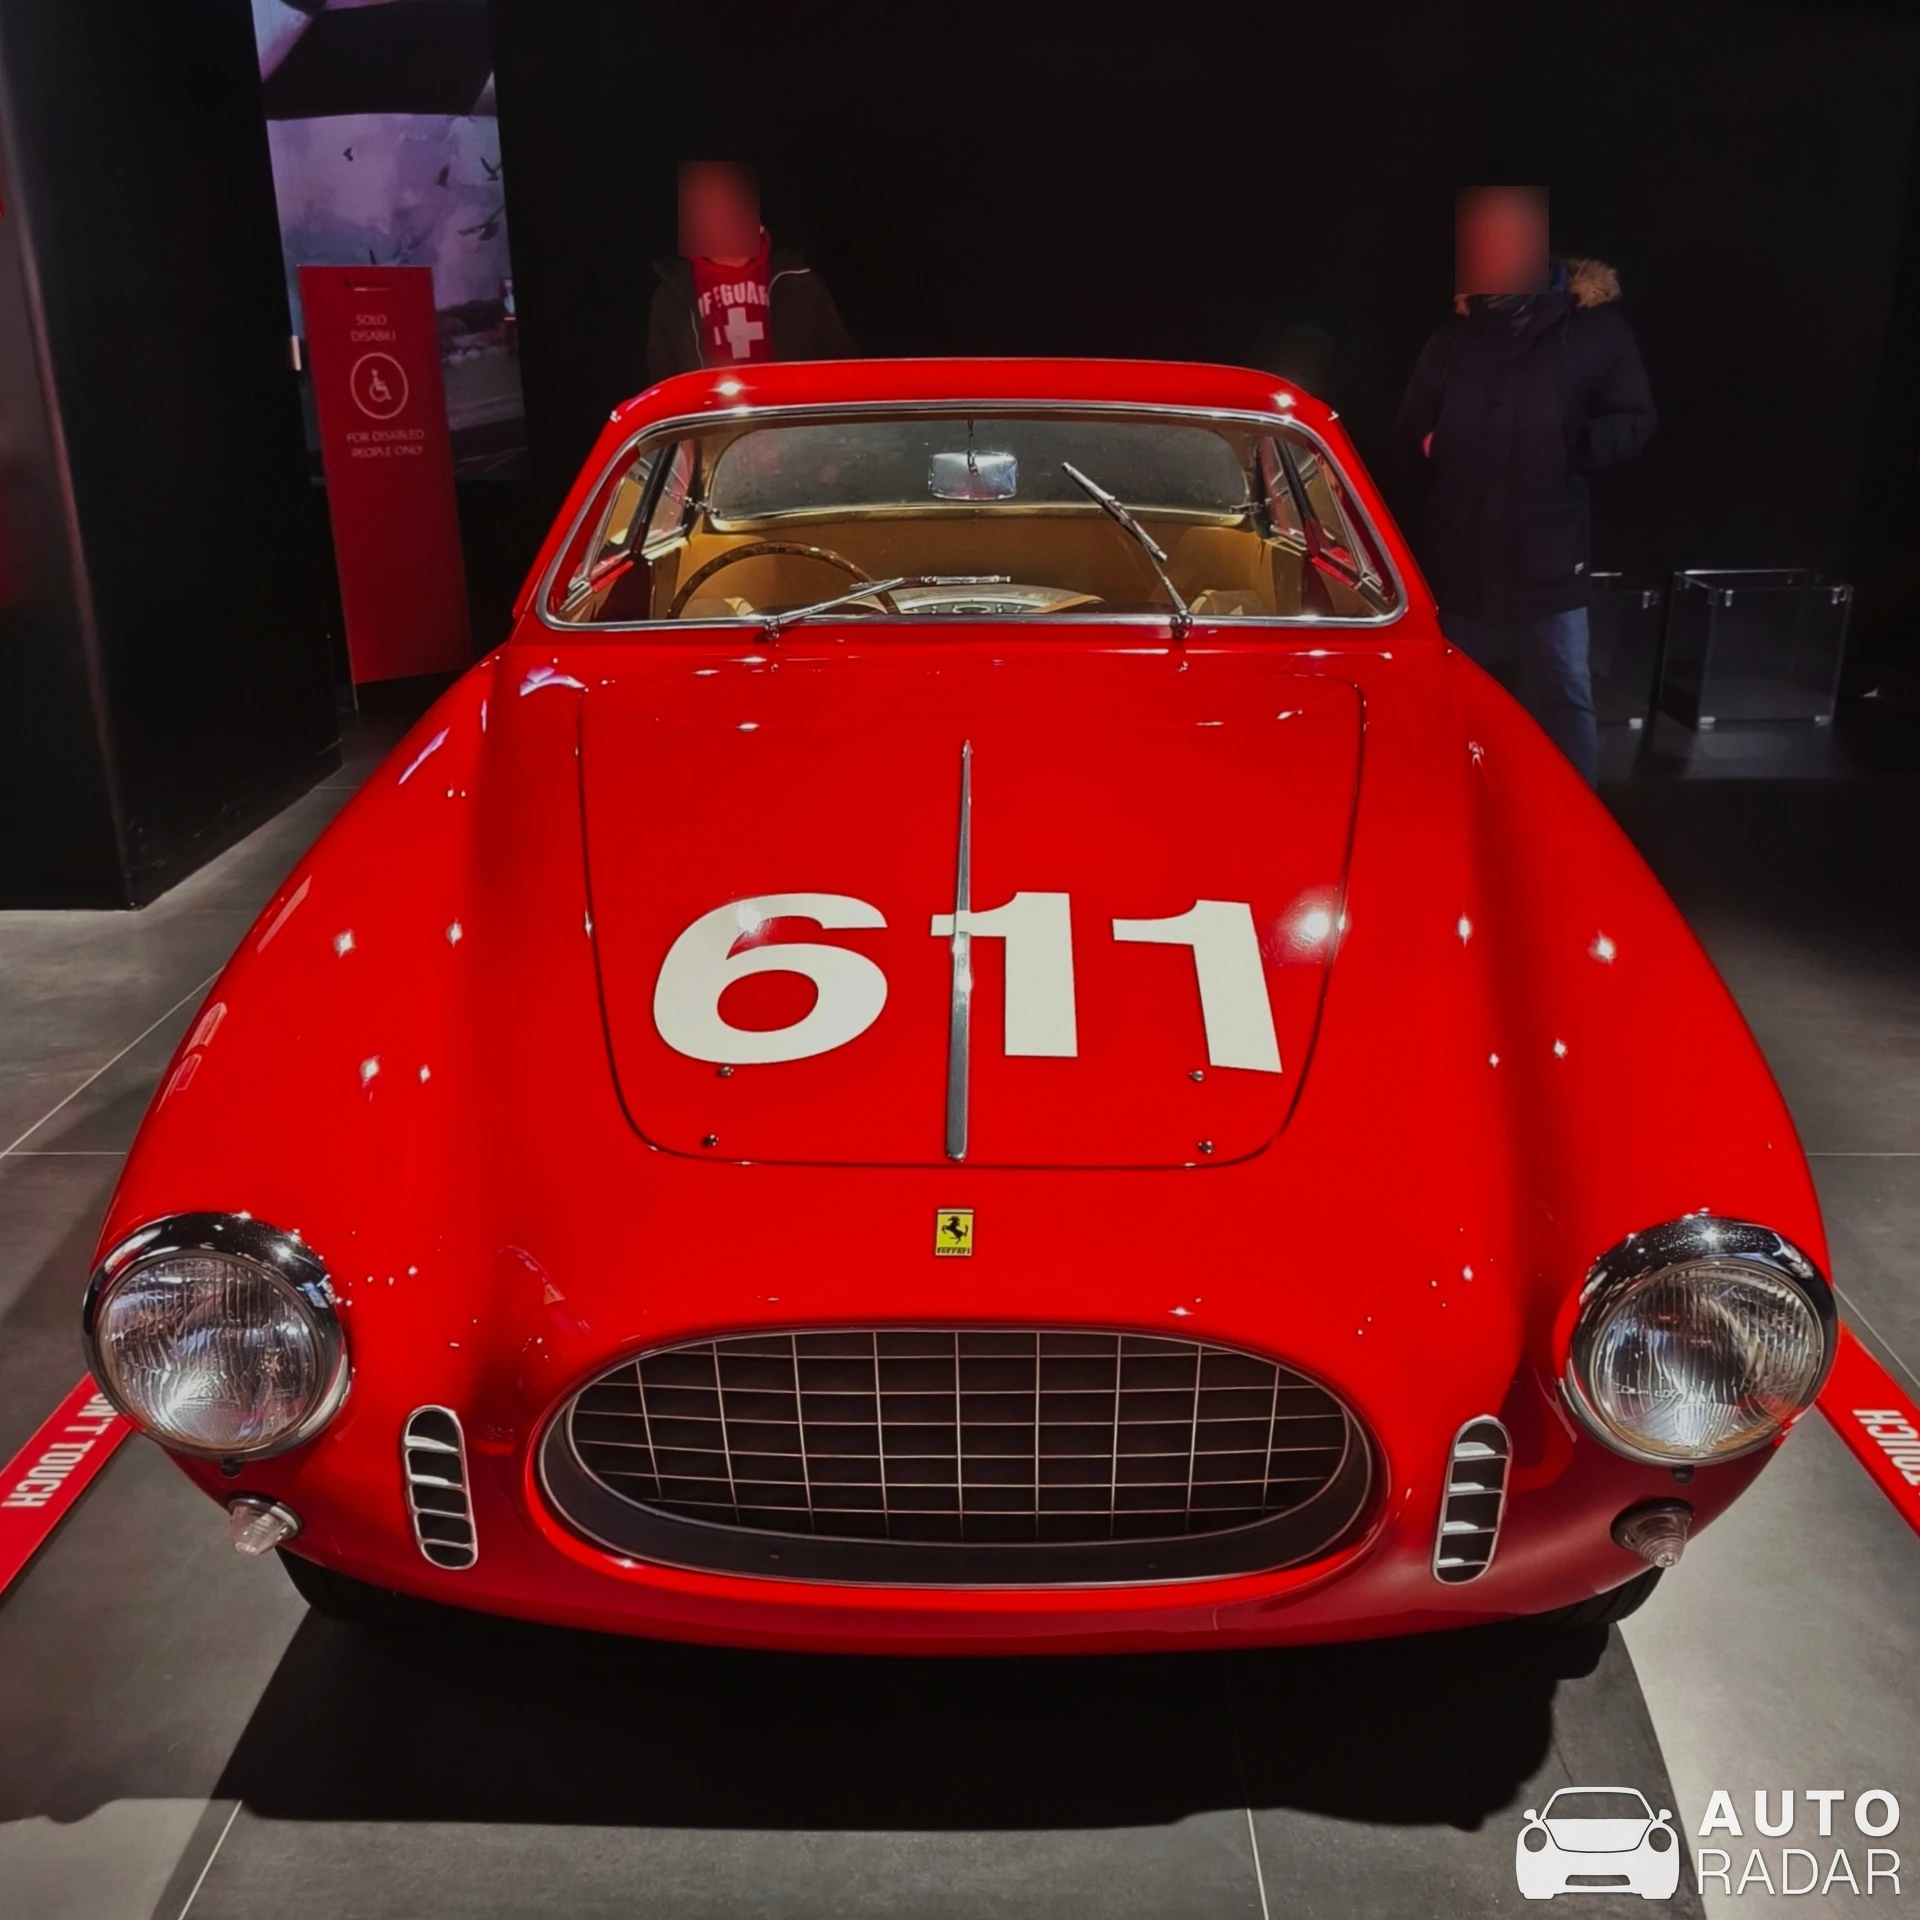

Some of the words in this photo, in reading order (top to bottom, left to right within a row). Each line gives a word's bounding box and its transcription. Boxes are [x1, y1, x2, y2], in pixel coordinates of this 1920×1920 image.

[355, 314, 388, 326] SOLO
[346, 432, 370, 443] FOR
[371, 429, 425, 442] DISABLED
[352, 446, 393, 458] PEOPLE
[394, 444, 424, 456] ONLY
[653, 892, 1283, 1073] 611
[0, 1439, 97, 1507] TOUCH
